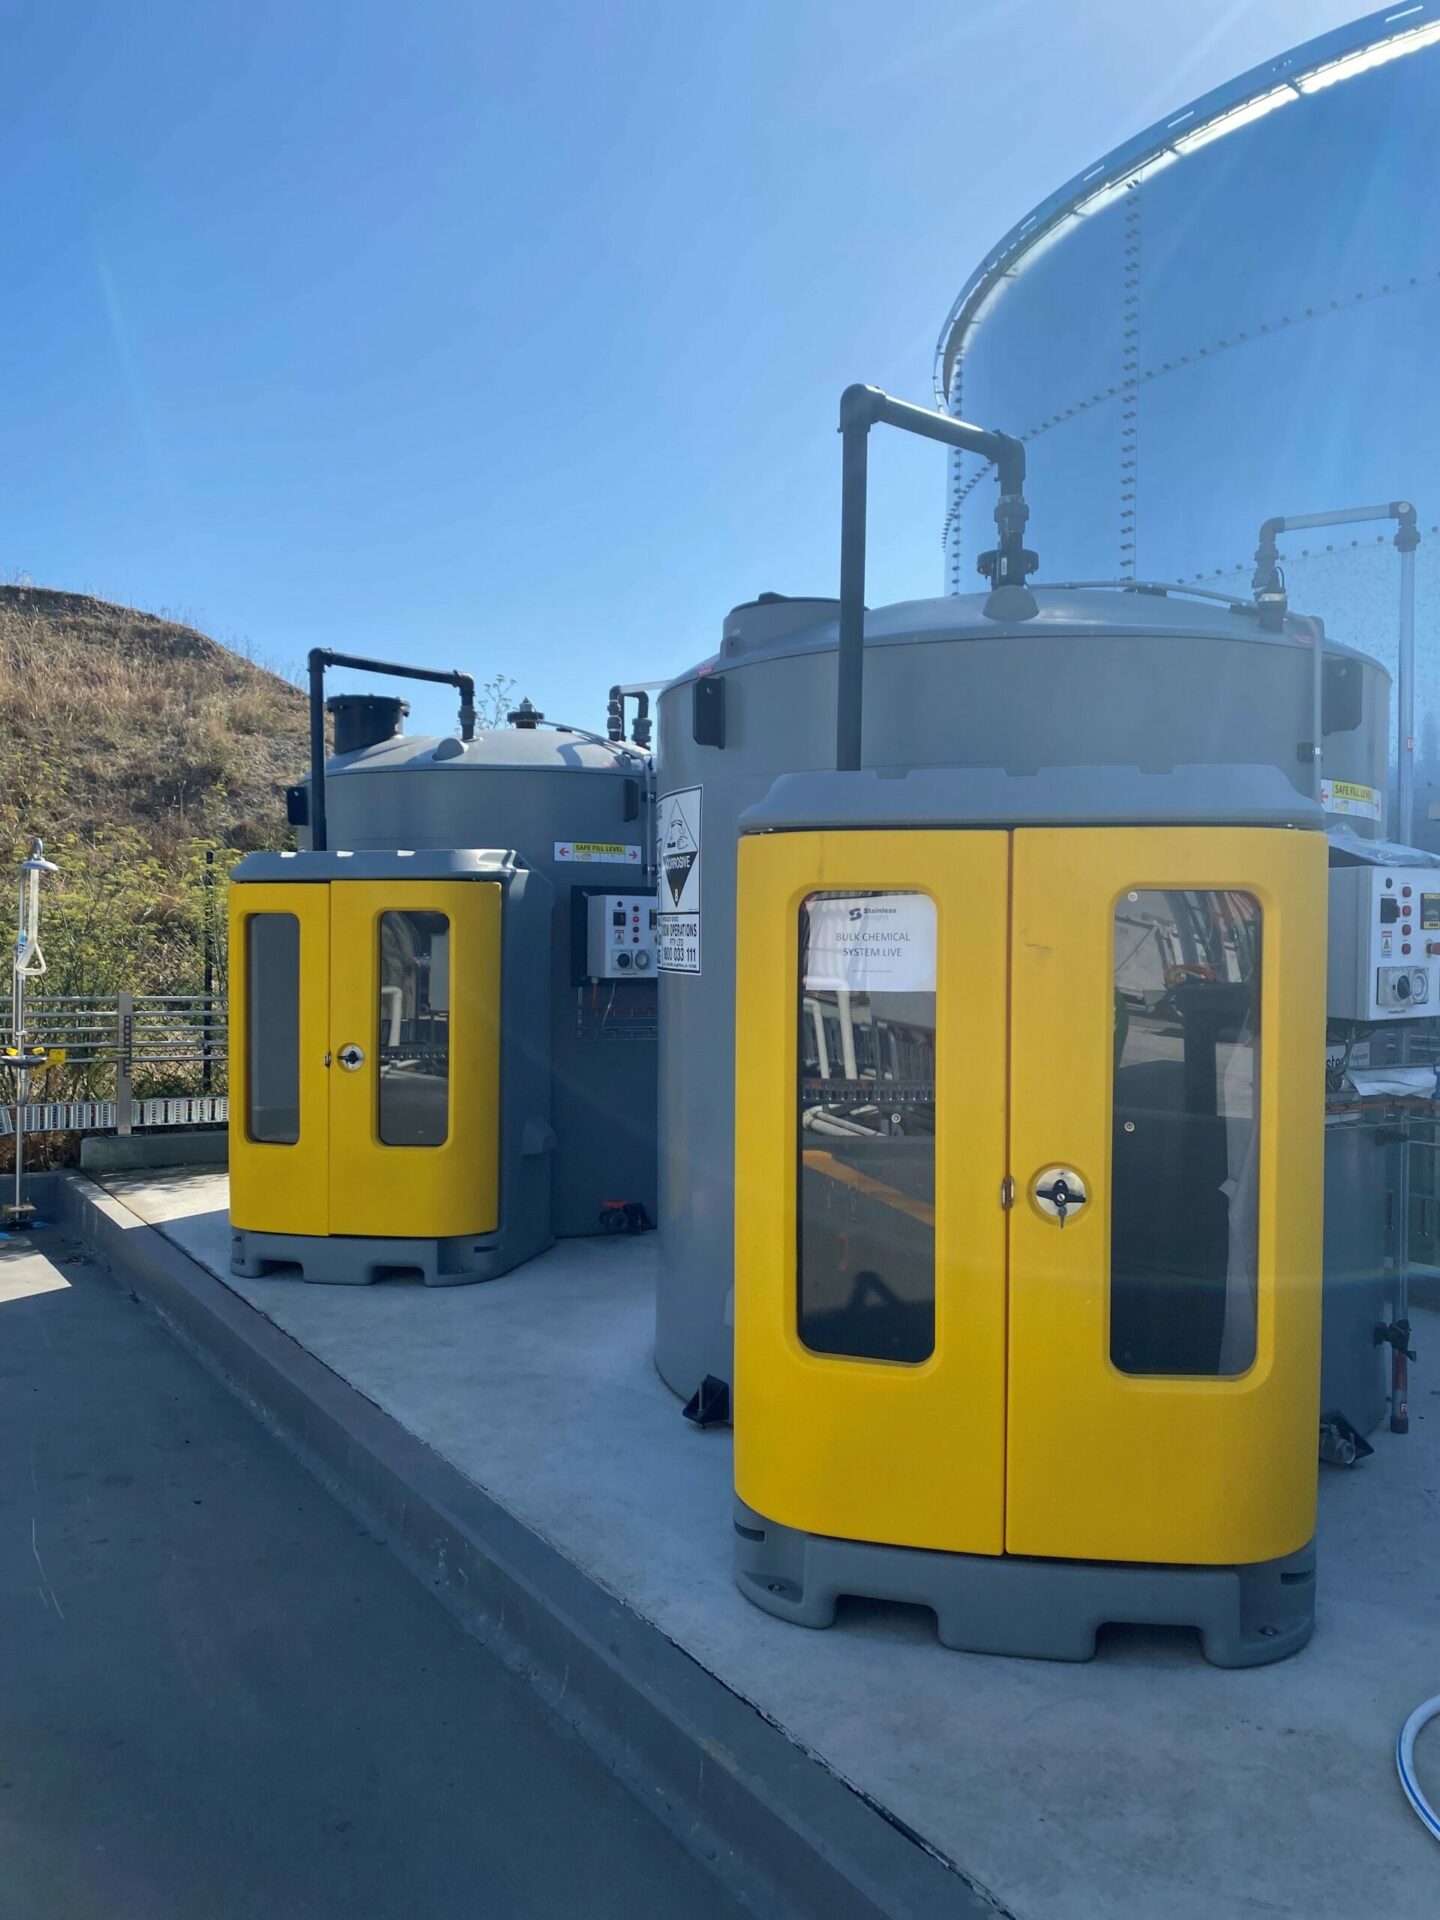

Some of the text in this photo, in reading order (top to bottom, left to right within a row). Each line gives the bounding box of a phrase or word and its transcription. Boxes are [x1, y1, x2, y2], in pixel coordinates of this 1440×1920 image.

[1335, 784, 1349, 796] SAFE
[674, 889, 679, 902] 8
[670, 924, 697, 937] OPERATIONS
[836, 932, 911, 941] BULK CHEMICAL
[673, 947, 684, 962] 033
[686, 948, 696, 962] 111
[843, 947, 902, 957] SYSTEM LIVE
